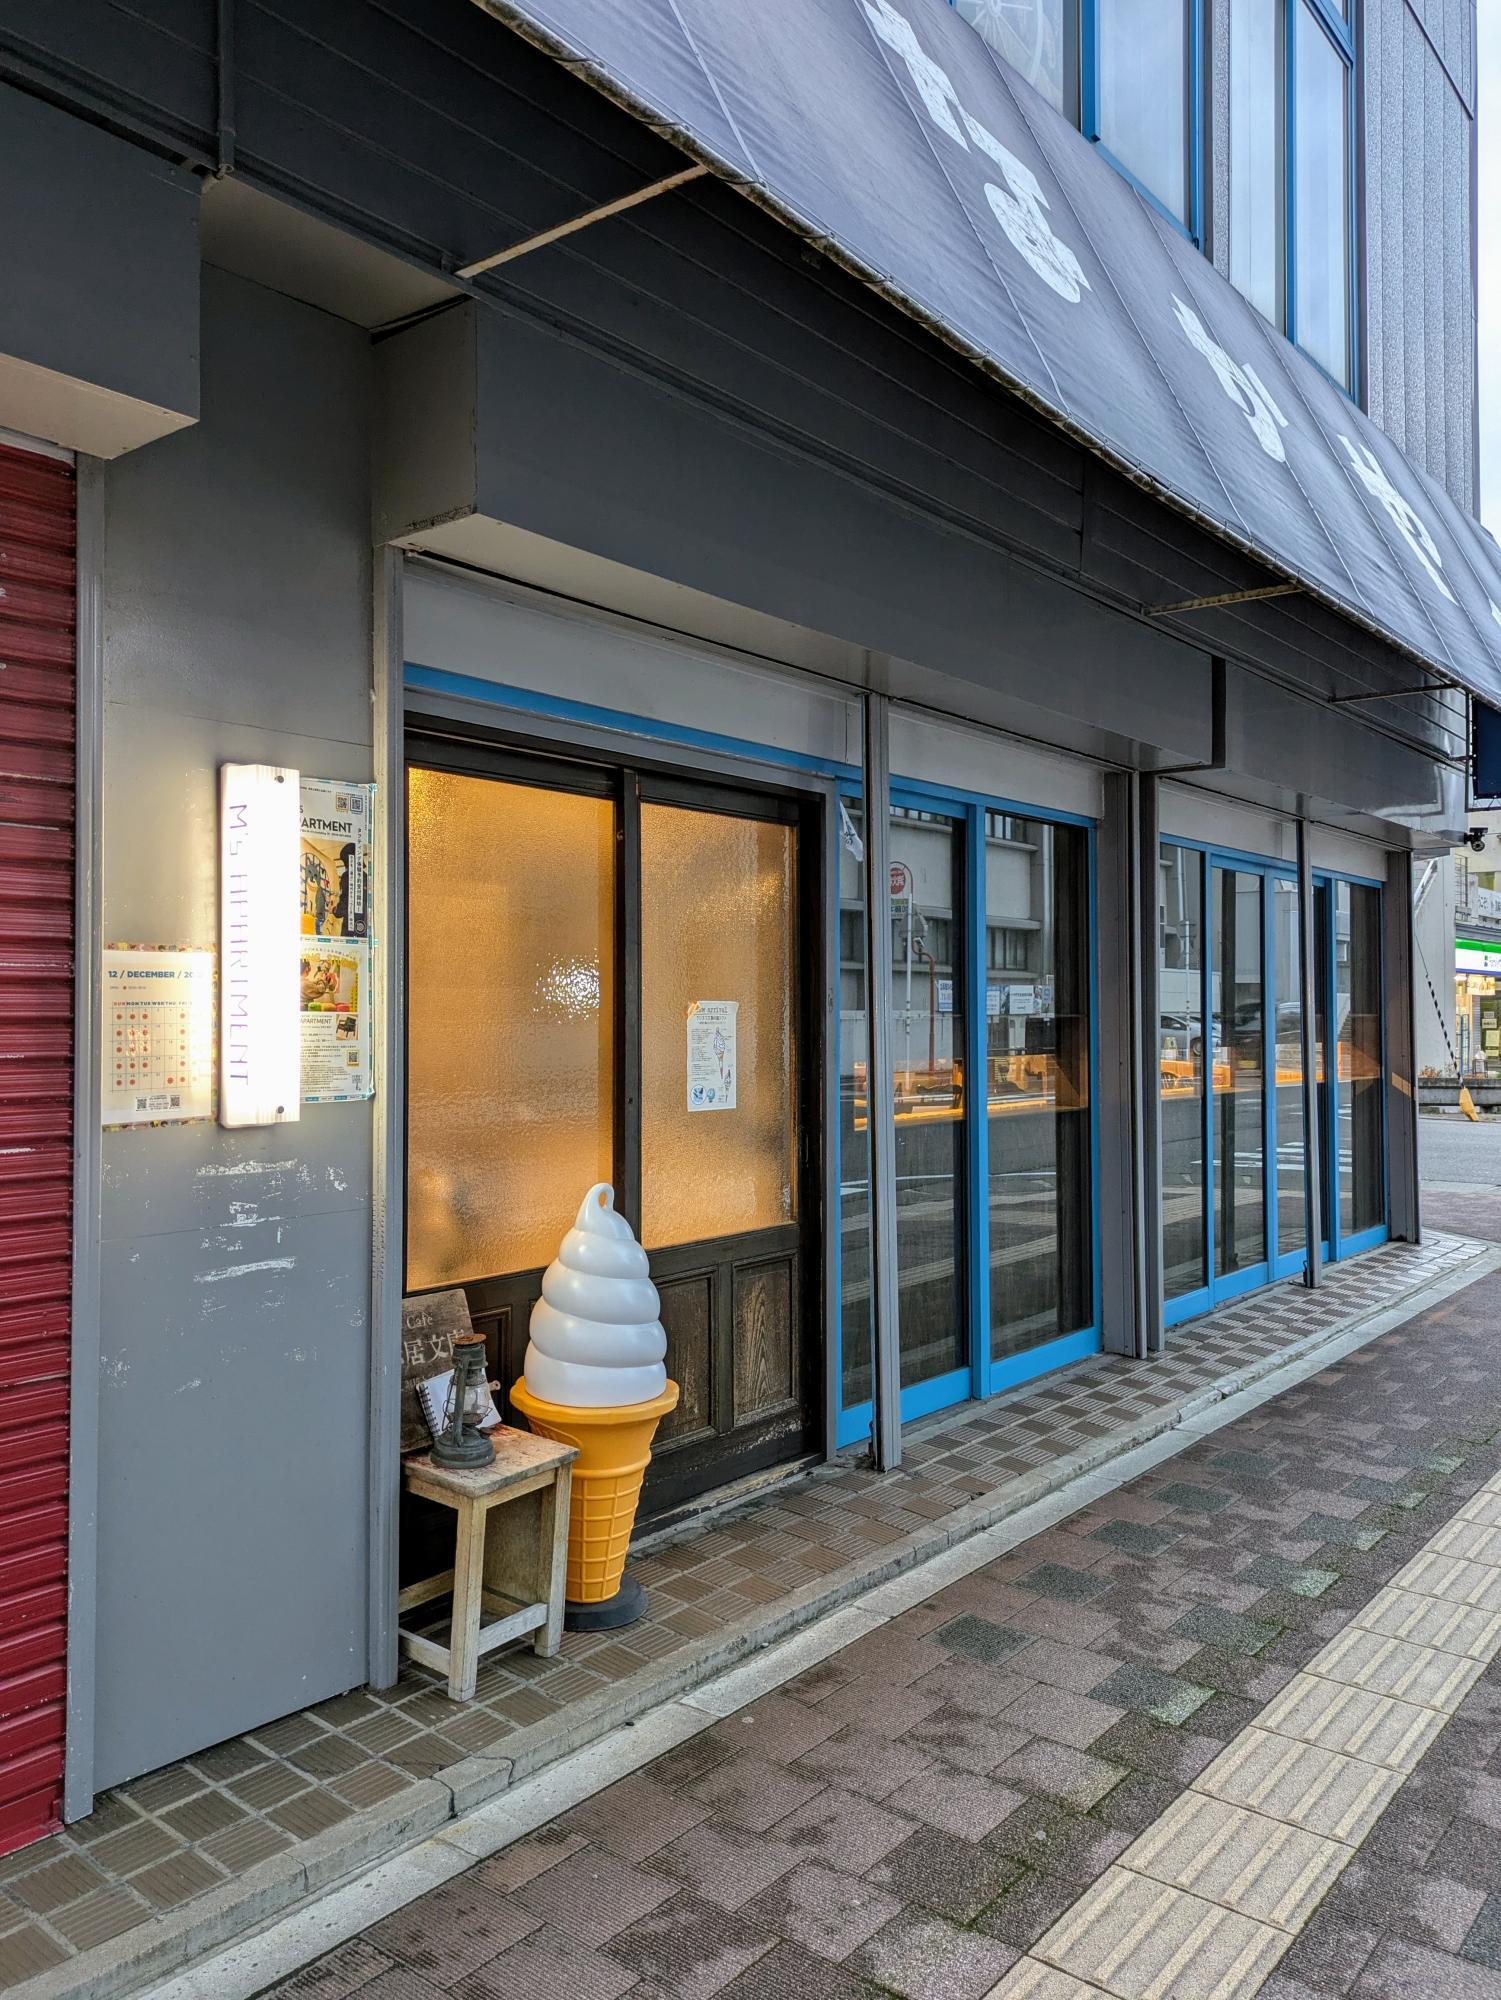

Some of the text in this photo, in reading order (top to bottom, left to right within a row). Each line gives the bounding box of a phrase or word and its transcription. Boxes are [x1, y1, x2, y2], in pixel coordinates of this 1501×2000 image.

[861, 0, 1501, 628] なかや
[300, 817, 352, 833] ARTMENT
